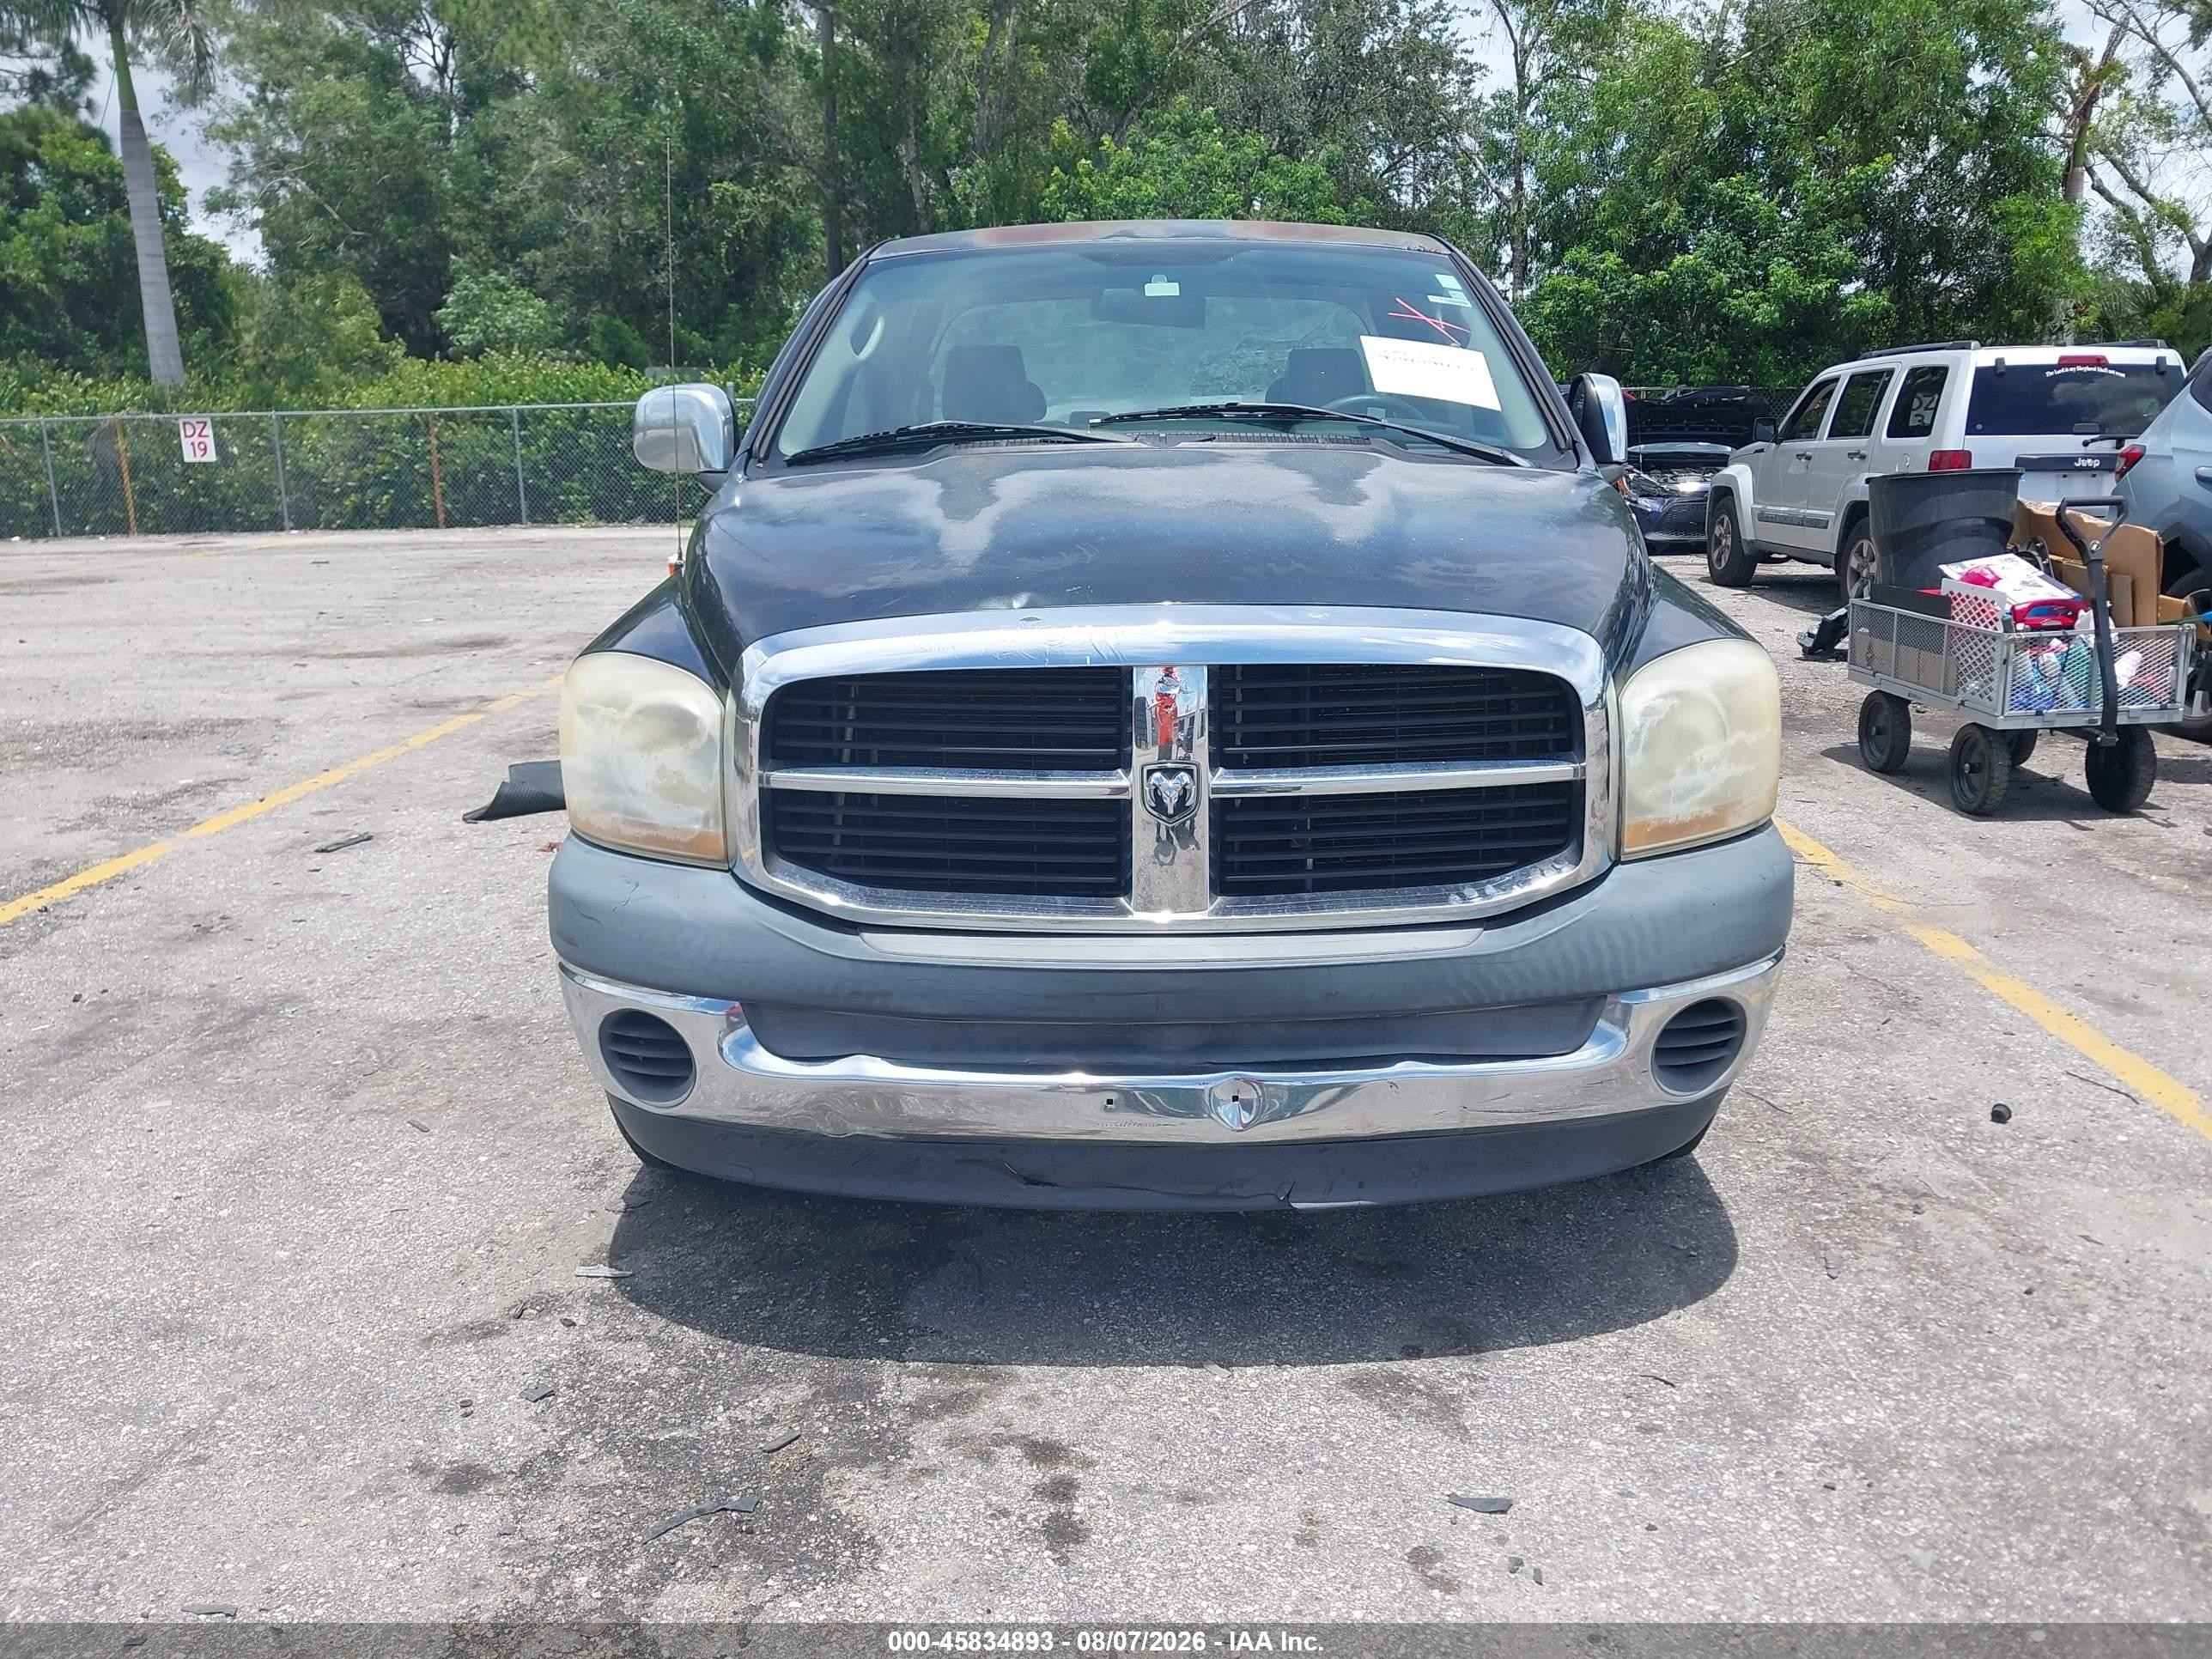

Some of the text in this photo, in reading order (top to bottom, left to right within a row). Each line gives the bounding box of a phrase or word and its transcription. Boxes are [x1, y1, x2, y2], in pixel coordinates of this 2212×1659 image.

[182, 421, 210, 438] DZ
[191, 441, 208, 458] 19
[2074, 458, 2100, 468] Jeep
